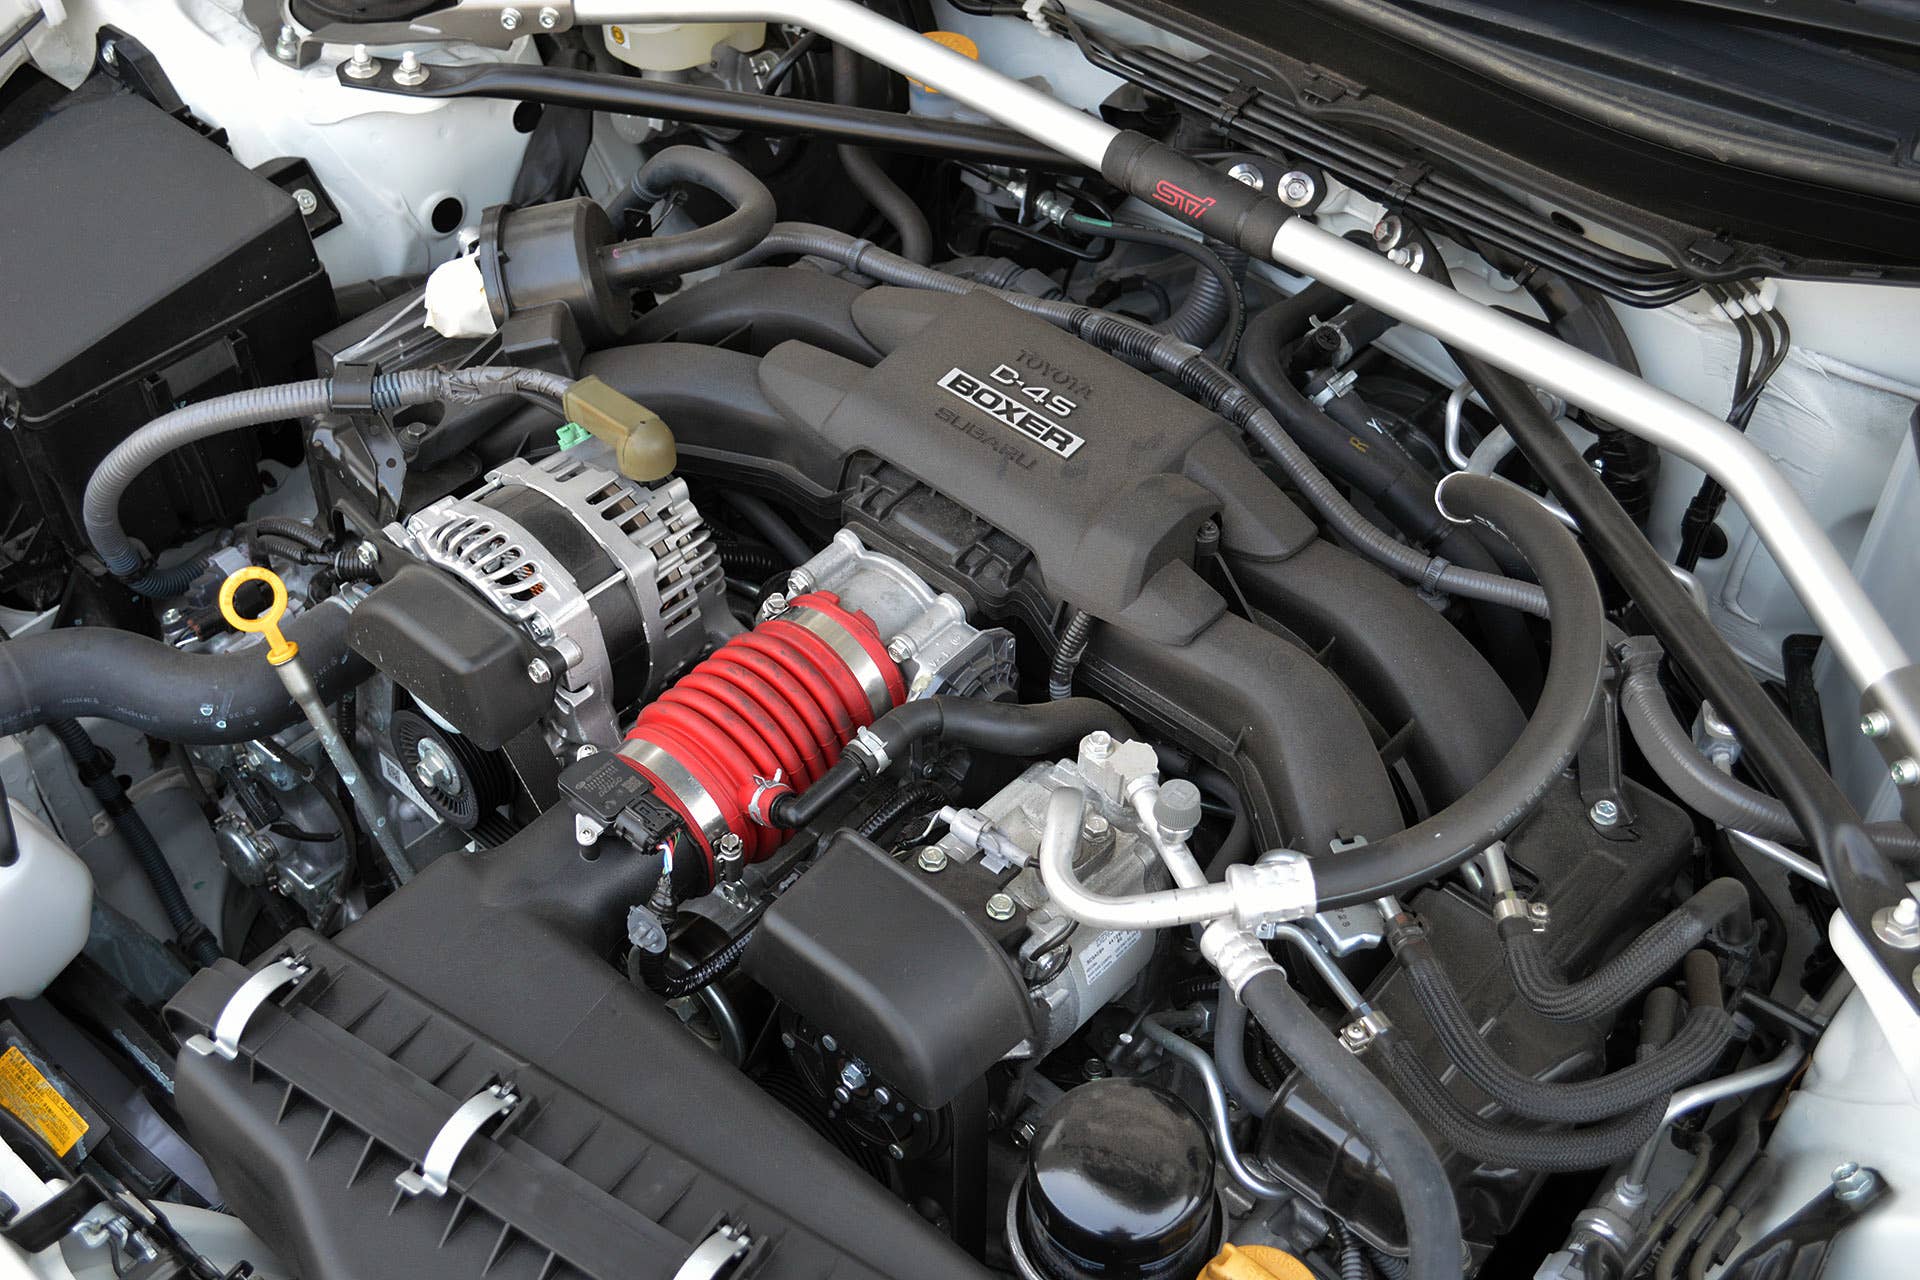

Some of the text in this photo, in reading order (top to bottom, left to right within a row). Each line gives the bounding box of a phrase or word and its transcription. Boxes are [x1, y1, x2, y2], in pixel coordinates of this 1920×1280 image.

[989, 363, 1078, 418] D-4S
[1015, 349, 1094, 401] TOYOTA
[935, 406, 1038, 470] SUBARU
[946, 373, 1075, 452] BOXER
